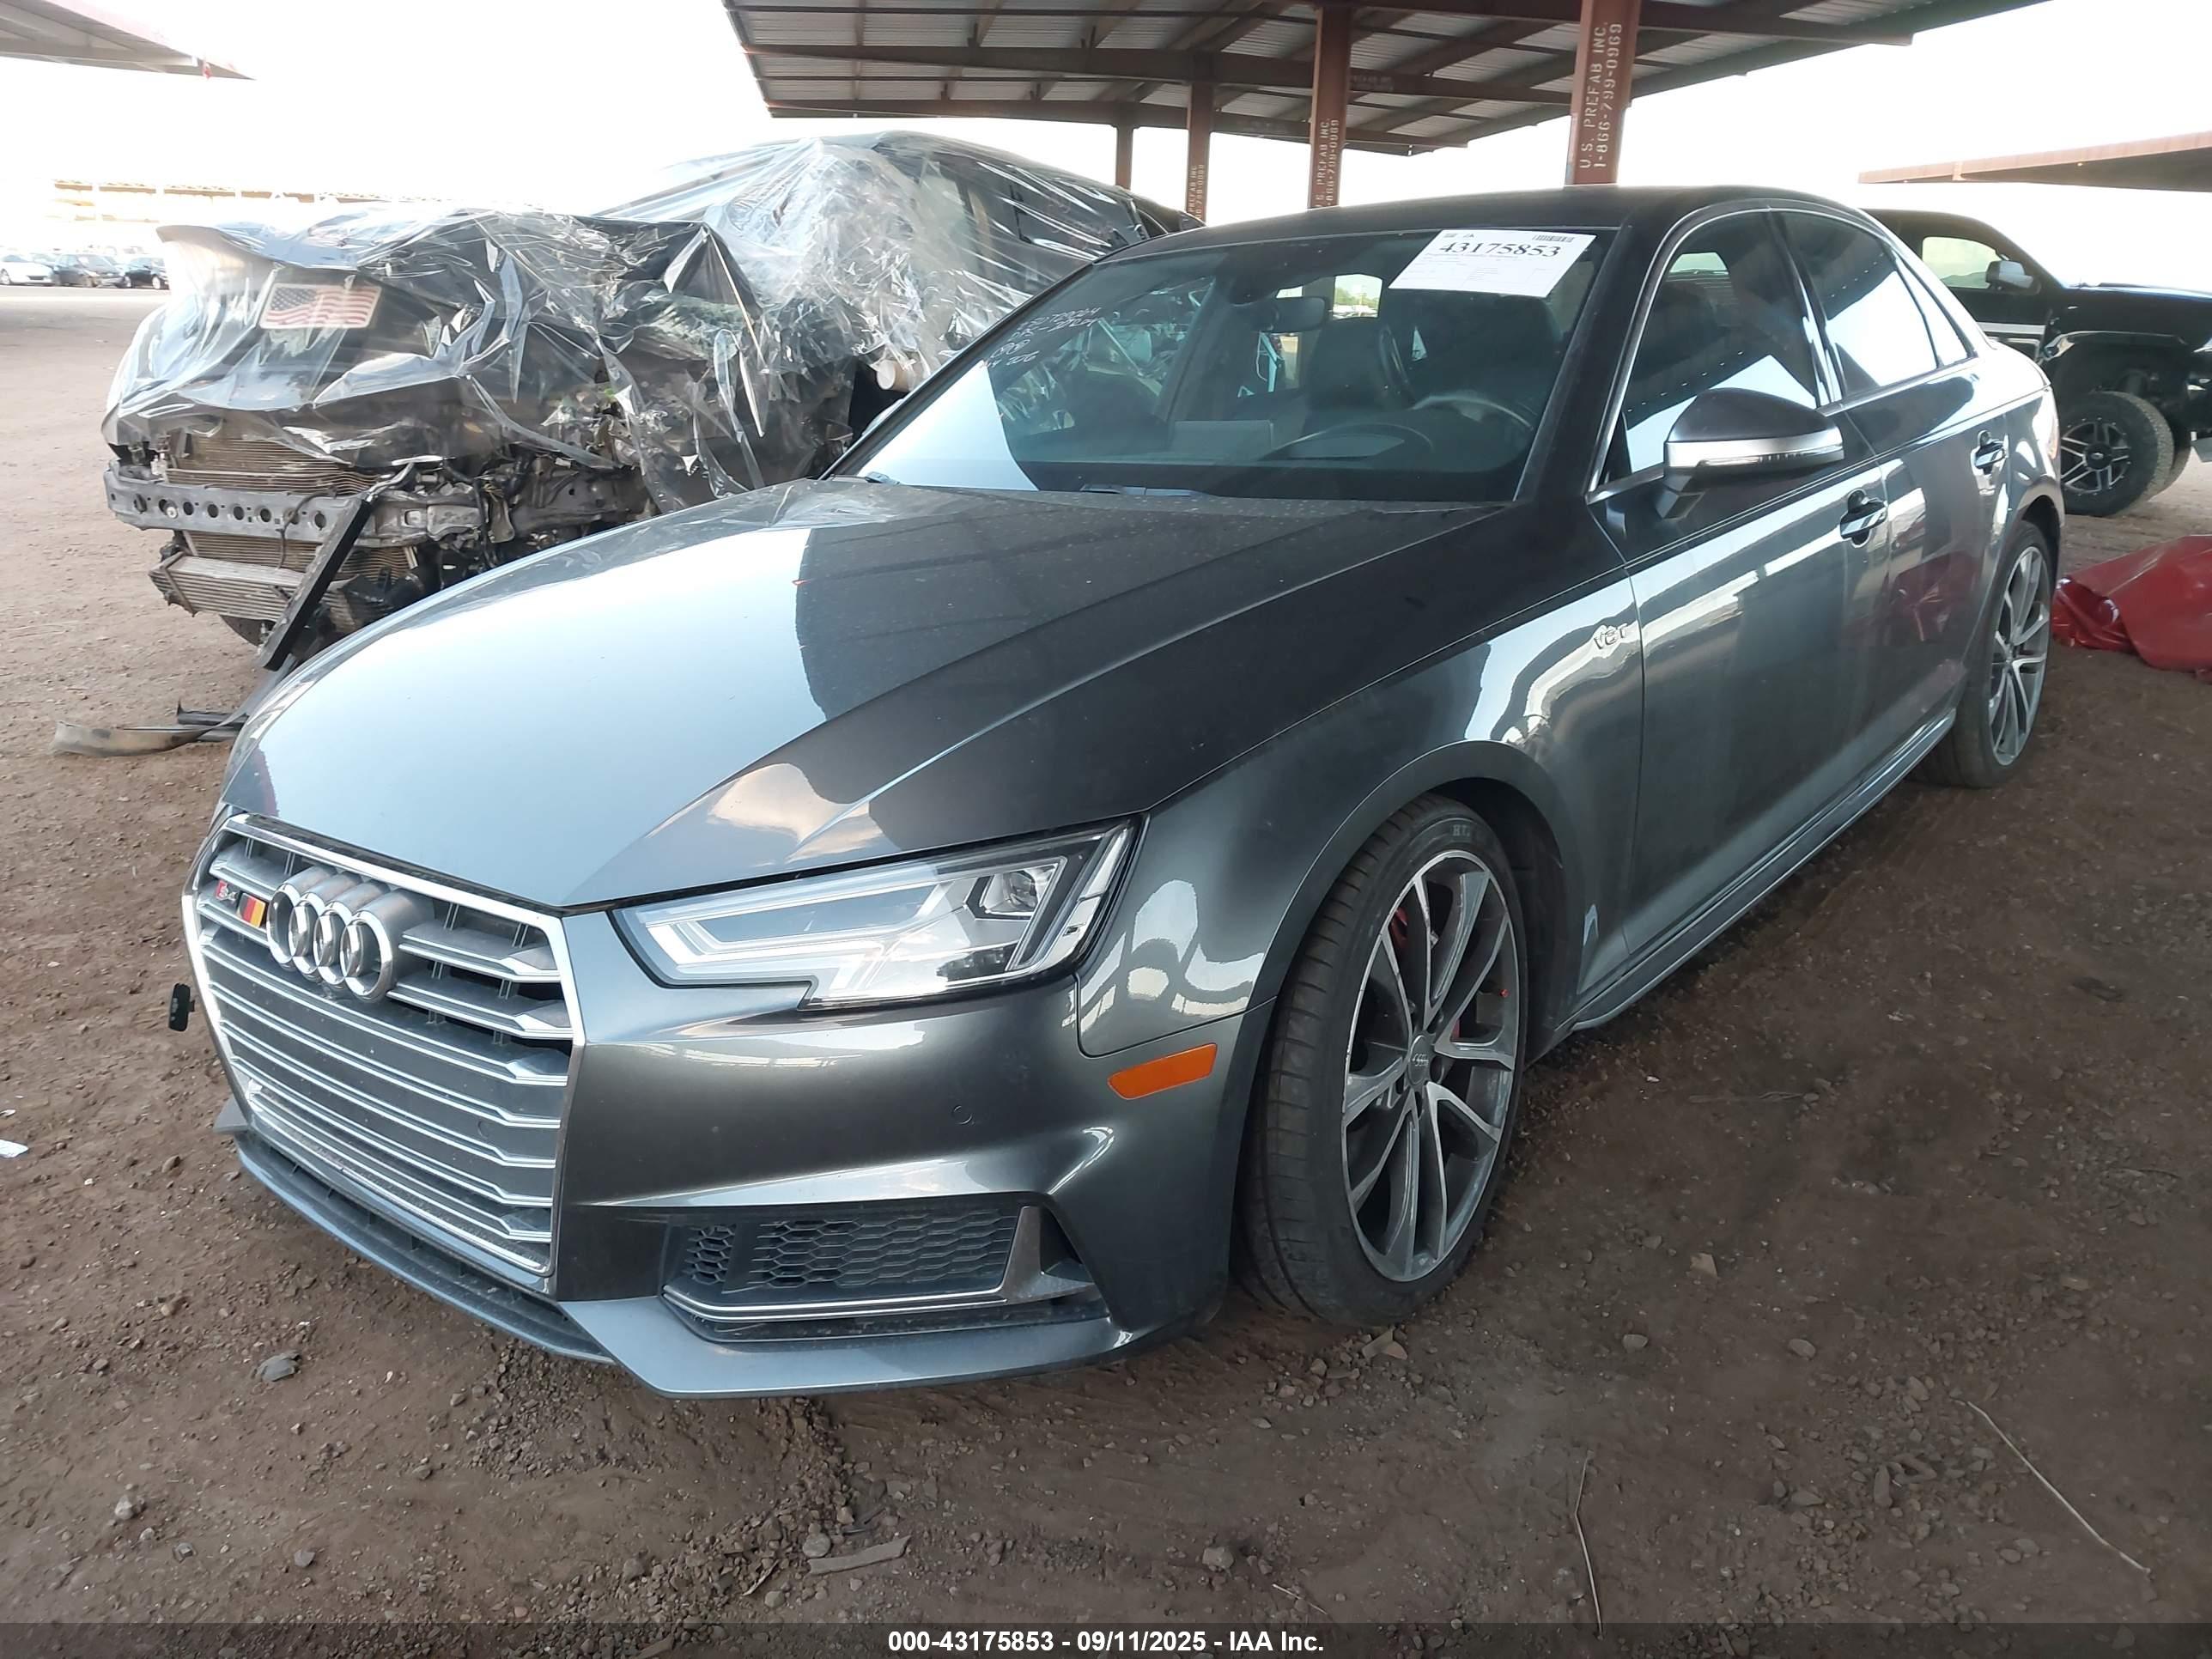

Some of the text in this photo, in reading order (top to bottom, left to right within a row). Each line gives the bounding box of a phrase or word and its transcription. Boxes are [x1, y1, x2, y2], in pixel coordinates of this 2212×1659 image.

[1592, 21, 1608, 53] INC.
[1583, 63, 1603, 128] PREFAB
[1594, 23, 1623, 167] 1-866-799-0969
[1438, 241, 1561, 257] 43175853
